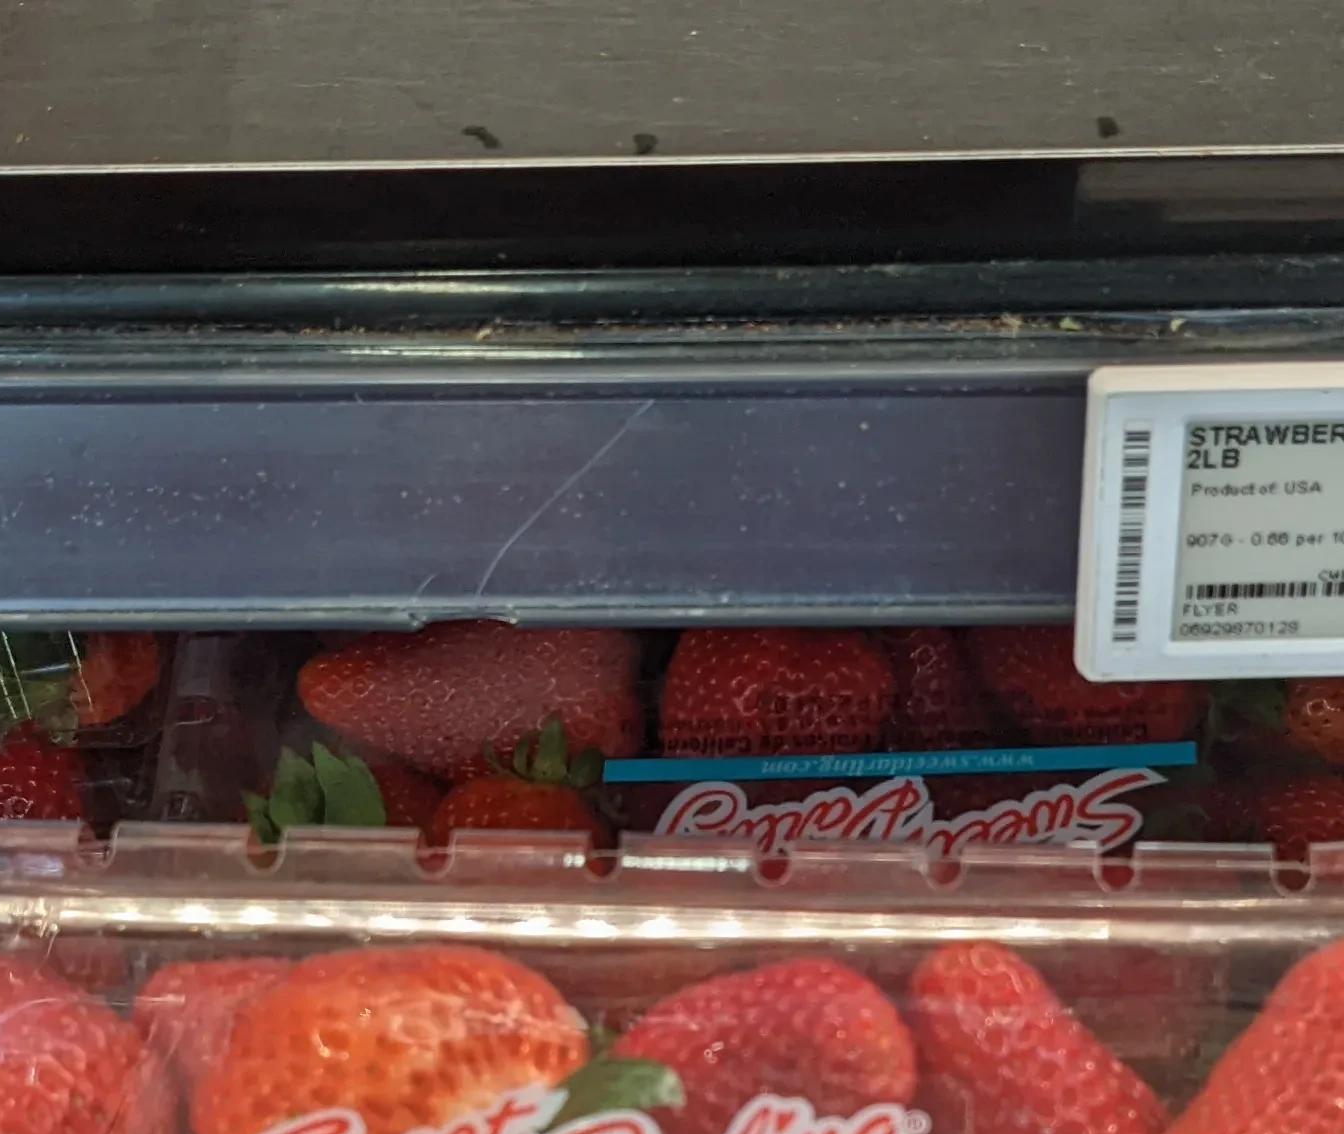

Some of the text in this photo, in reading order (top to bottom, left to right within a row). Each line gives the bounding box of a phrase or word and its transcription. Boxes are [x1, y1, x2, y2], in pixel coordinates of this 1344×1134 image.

[1187, 449, 1240, 469] 2LB
[1190, 481, 1255, 497] Product
[1283, 479, 1323, 496] USA
[1182, 601, 1238, 617] FLYER
